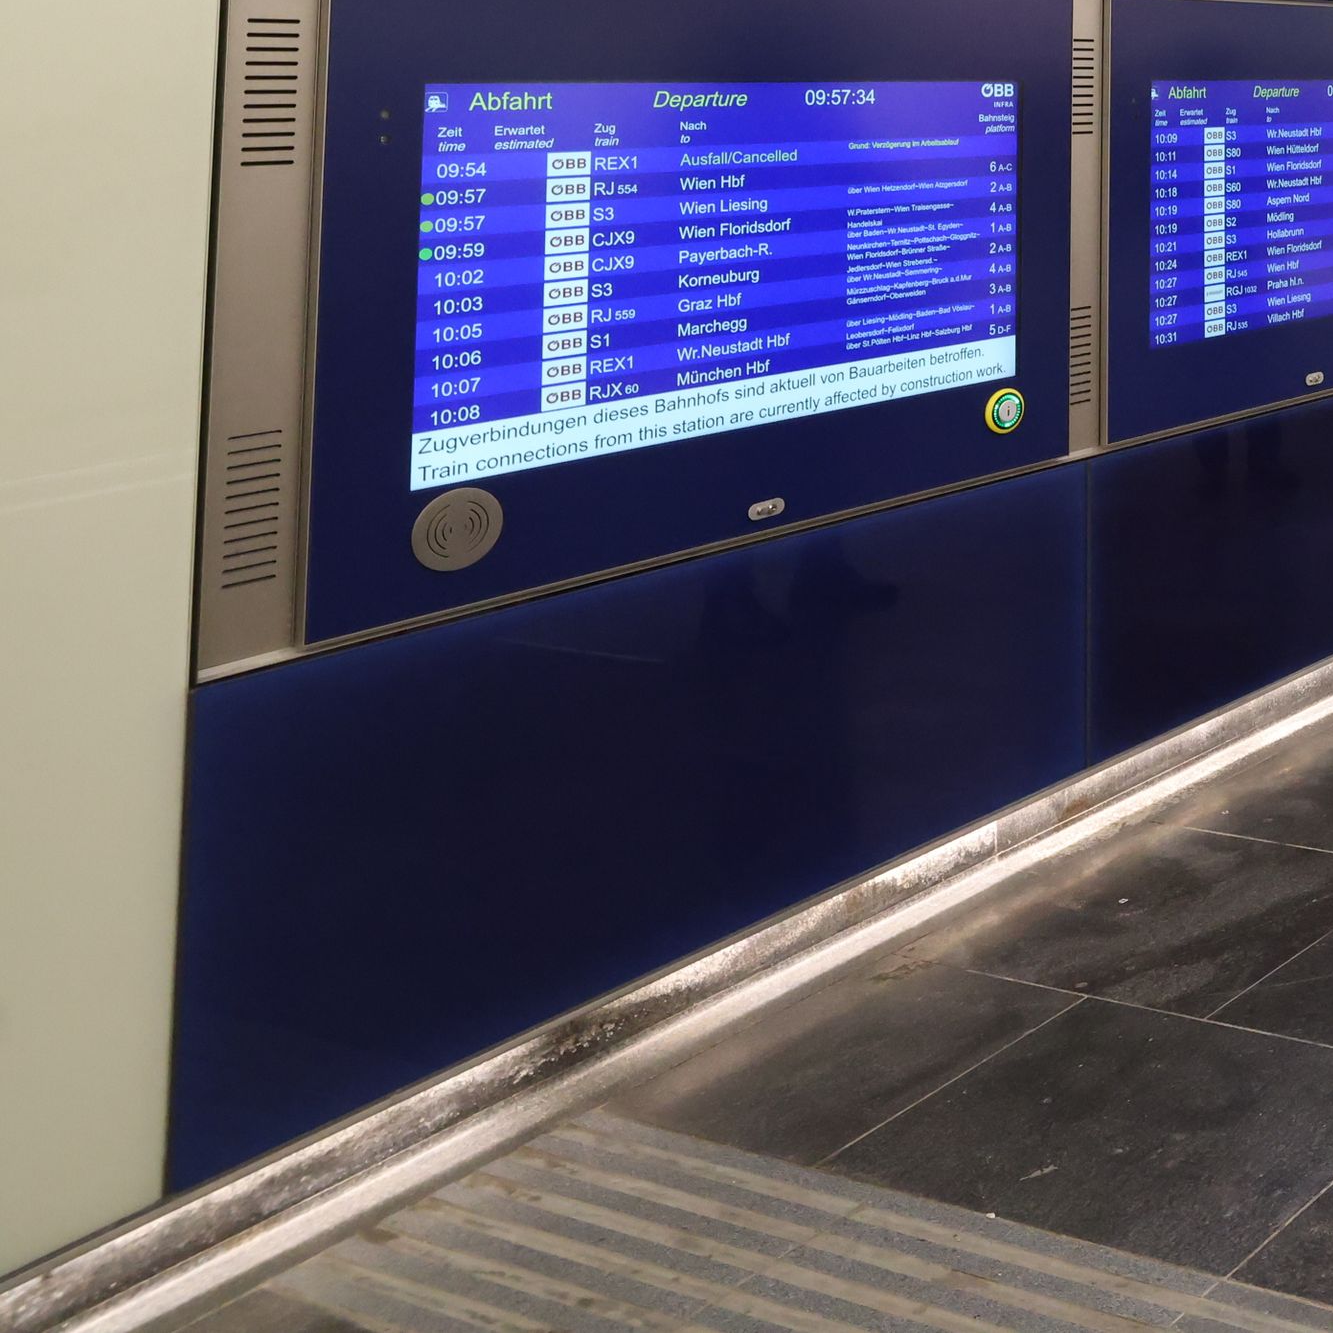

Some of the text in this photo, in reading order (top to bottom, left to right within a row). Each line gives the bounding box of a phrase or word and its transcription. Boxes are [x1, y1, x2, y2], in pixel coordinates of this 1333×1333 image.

[468, 83, 1014, 111] Abfahrt Departure 09:57:34 ÖBB
[1167, 85, 1206, 99] Abfahrt
[1252, 85, 1299, 100] Departure
[437, 113, 1014, 138] Zeit Erwartet Zug Nach Bahnsteig
[984, 123, 1015, 134] platform
[435, 160, 1012, 205] 09:57 RJ 554 Wien Hbf 6 A-C
[436, 148, 797, 178] 09:54 ÖBB REX1 Ausfall/Cancelled
[1154, 211, 1294, 235] 10:19 S2 Mödling
[434, 242, 772, 287] 10:02 CJX9 Payerbach-R.
[1154, 294, 1177, 308] 10:27
[1224, 284, 1243, 298] RGJ
[1266, 278, 1288, 290] Praha
[1289, 276, 1304, 286] hl.n.
[432, 292, 742, 343] 10:05 RJ 559 Graz Hbf
[431, 318, 747, 370] 10:06 S1 Marchegg
[431, 332, 790, 398] 10:07 REX1 Wr.Neustadt Hbf
[430, 323, 1011, 426] 10:08 ÖBB RJX 60 München Hbf 5 D-F
[417, 346, 984, 455] Zugverbindungen dieses Bahnhofs sind aktuell von Bauarbeiten betroffen.
[417, 362, 1009, 482] Train connections from this station are currently affected by construction work.
